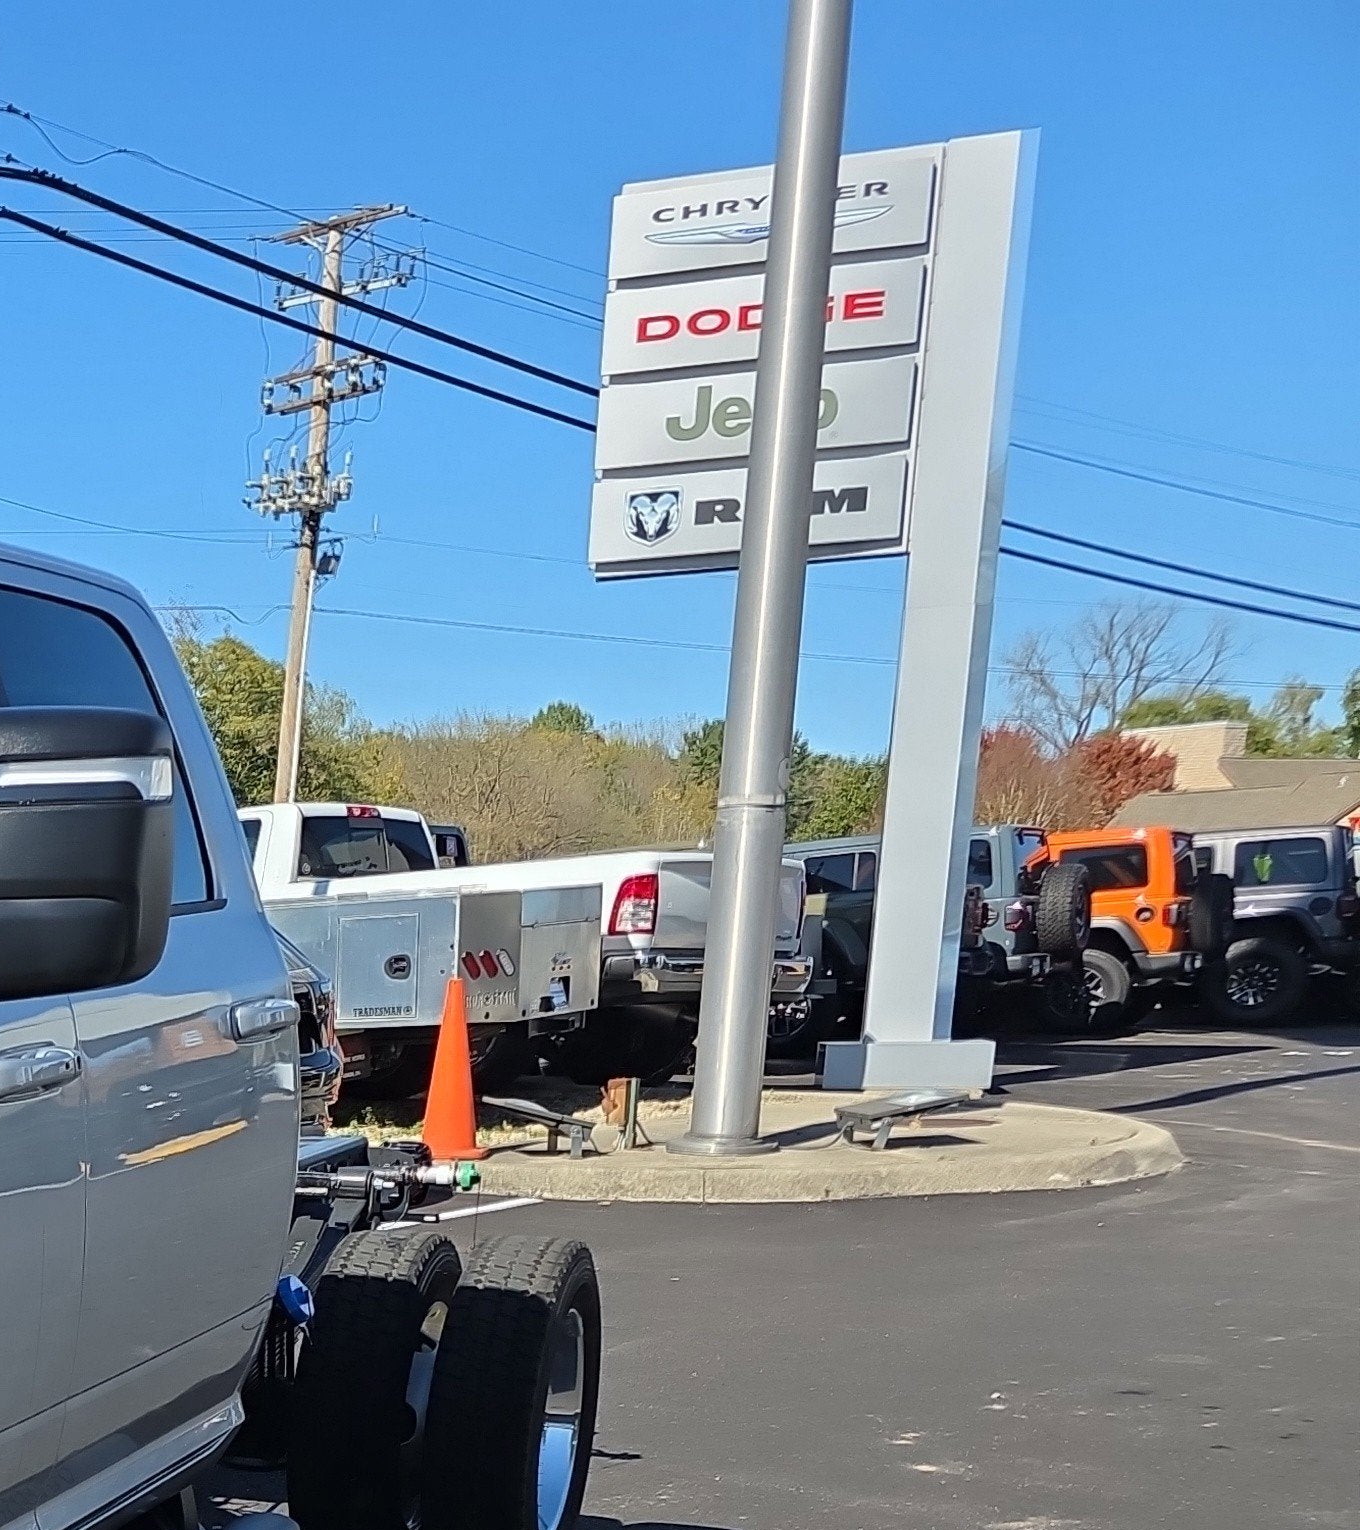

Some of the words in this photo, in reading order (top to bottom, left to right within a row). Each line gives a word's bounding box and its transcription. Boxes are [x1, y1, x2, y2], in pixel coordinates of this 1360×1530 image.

[651, 181, 890, 223] CHRYER
[636, 290, 886, 344] DODE
[694, 486, 869, 526] RM
[353, 1006, 402, 1018] TRADESMAN
